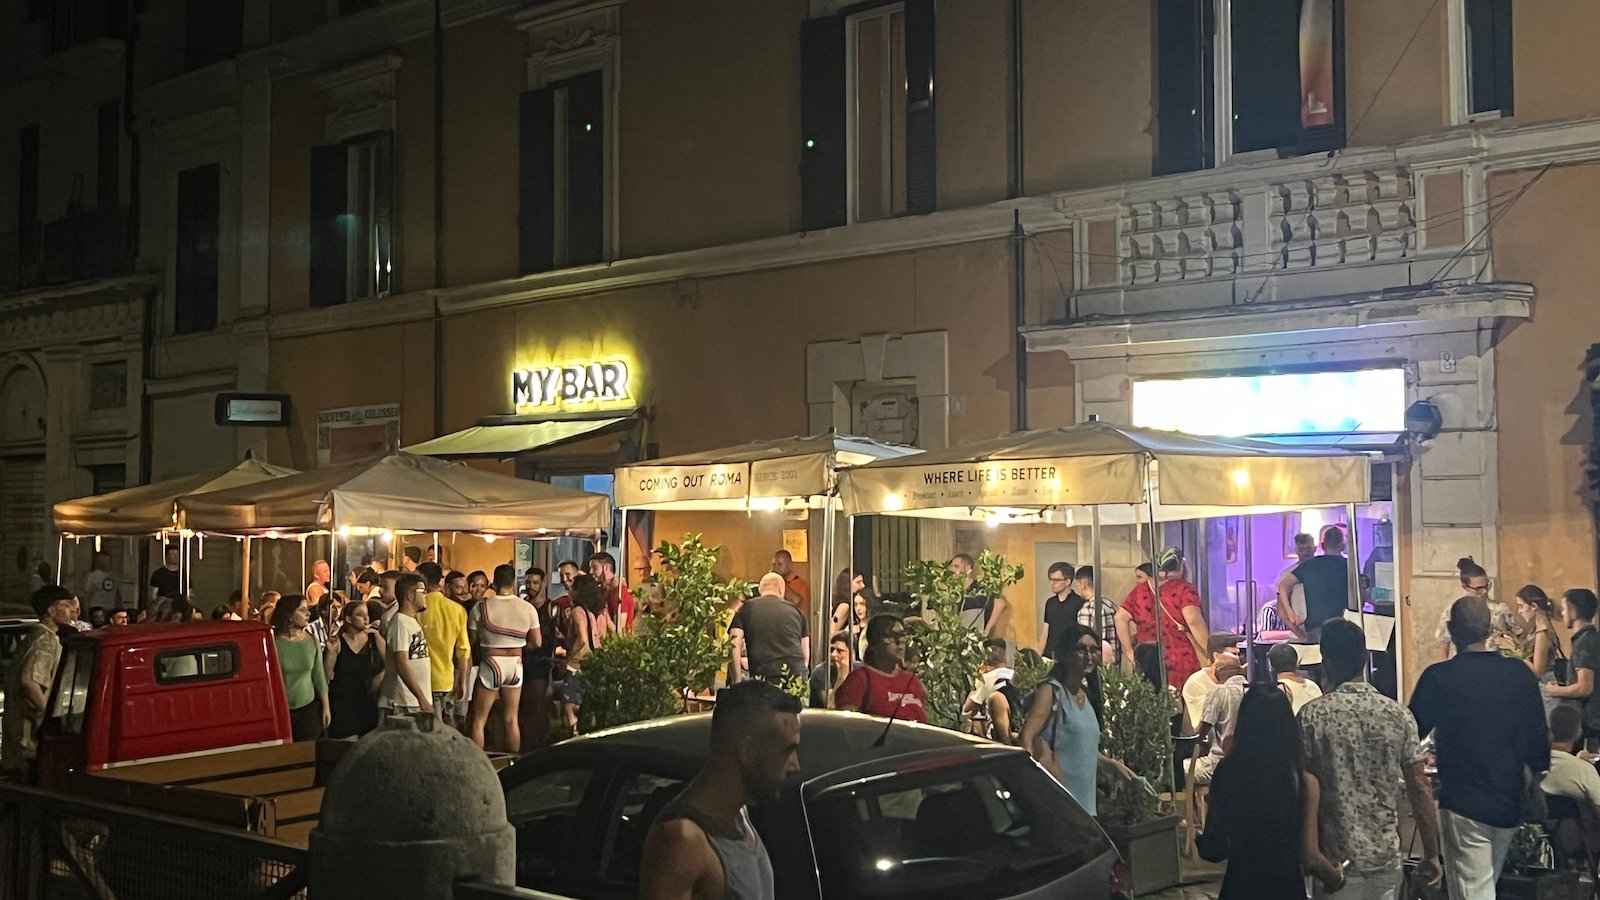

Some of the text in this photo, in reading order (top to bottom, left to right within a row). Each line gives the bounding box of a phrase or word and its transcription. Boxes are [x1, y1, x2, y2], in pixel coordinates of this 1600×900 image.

[514, 360, 629, 406] MY BAR
[639, 471, 742, 492] COMING OUT ROMA
[924, 470, 964, 485] WHERE
[968, 468, 993, 482] LIFE
[1011, 467, 1056, 481] BETTER
